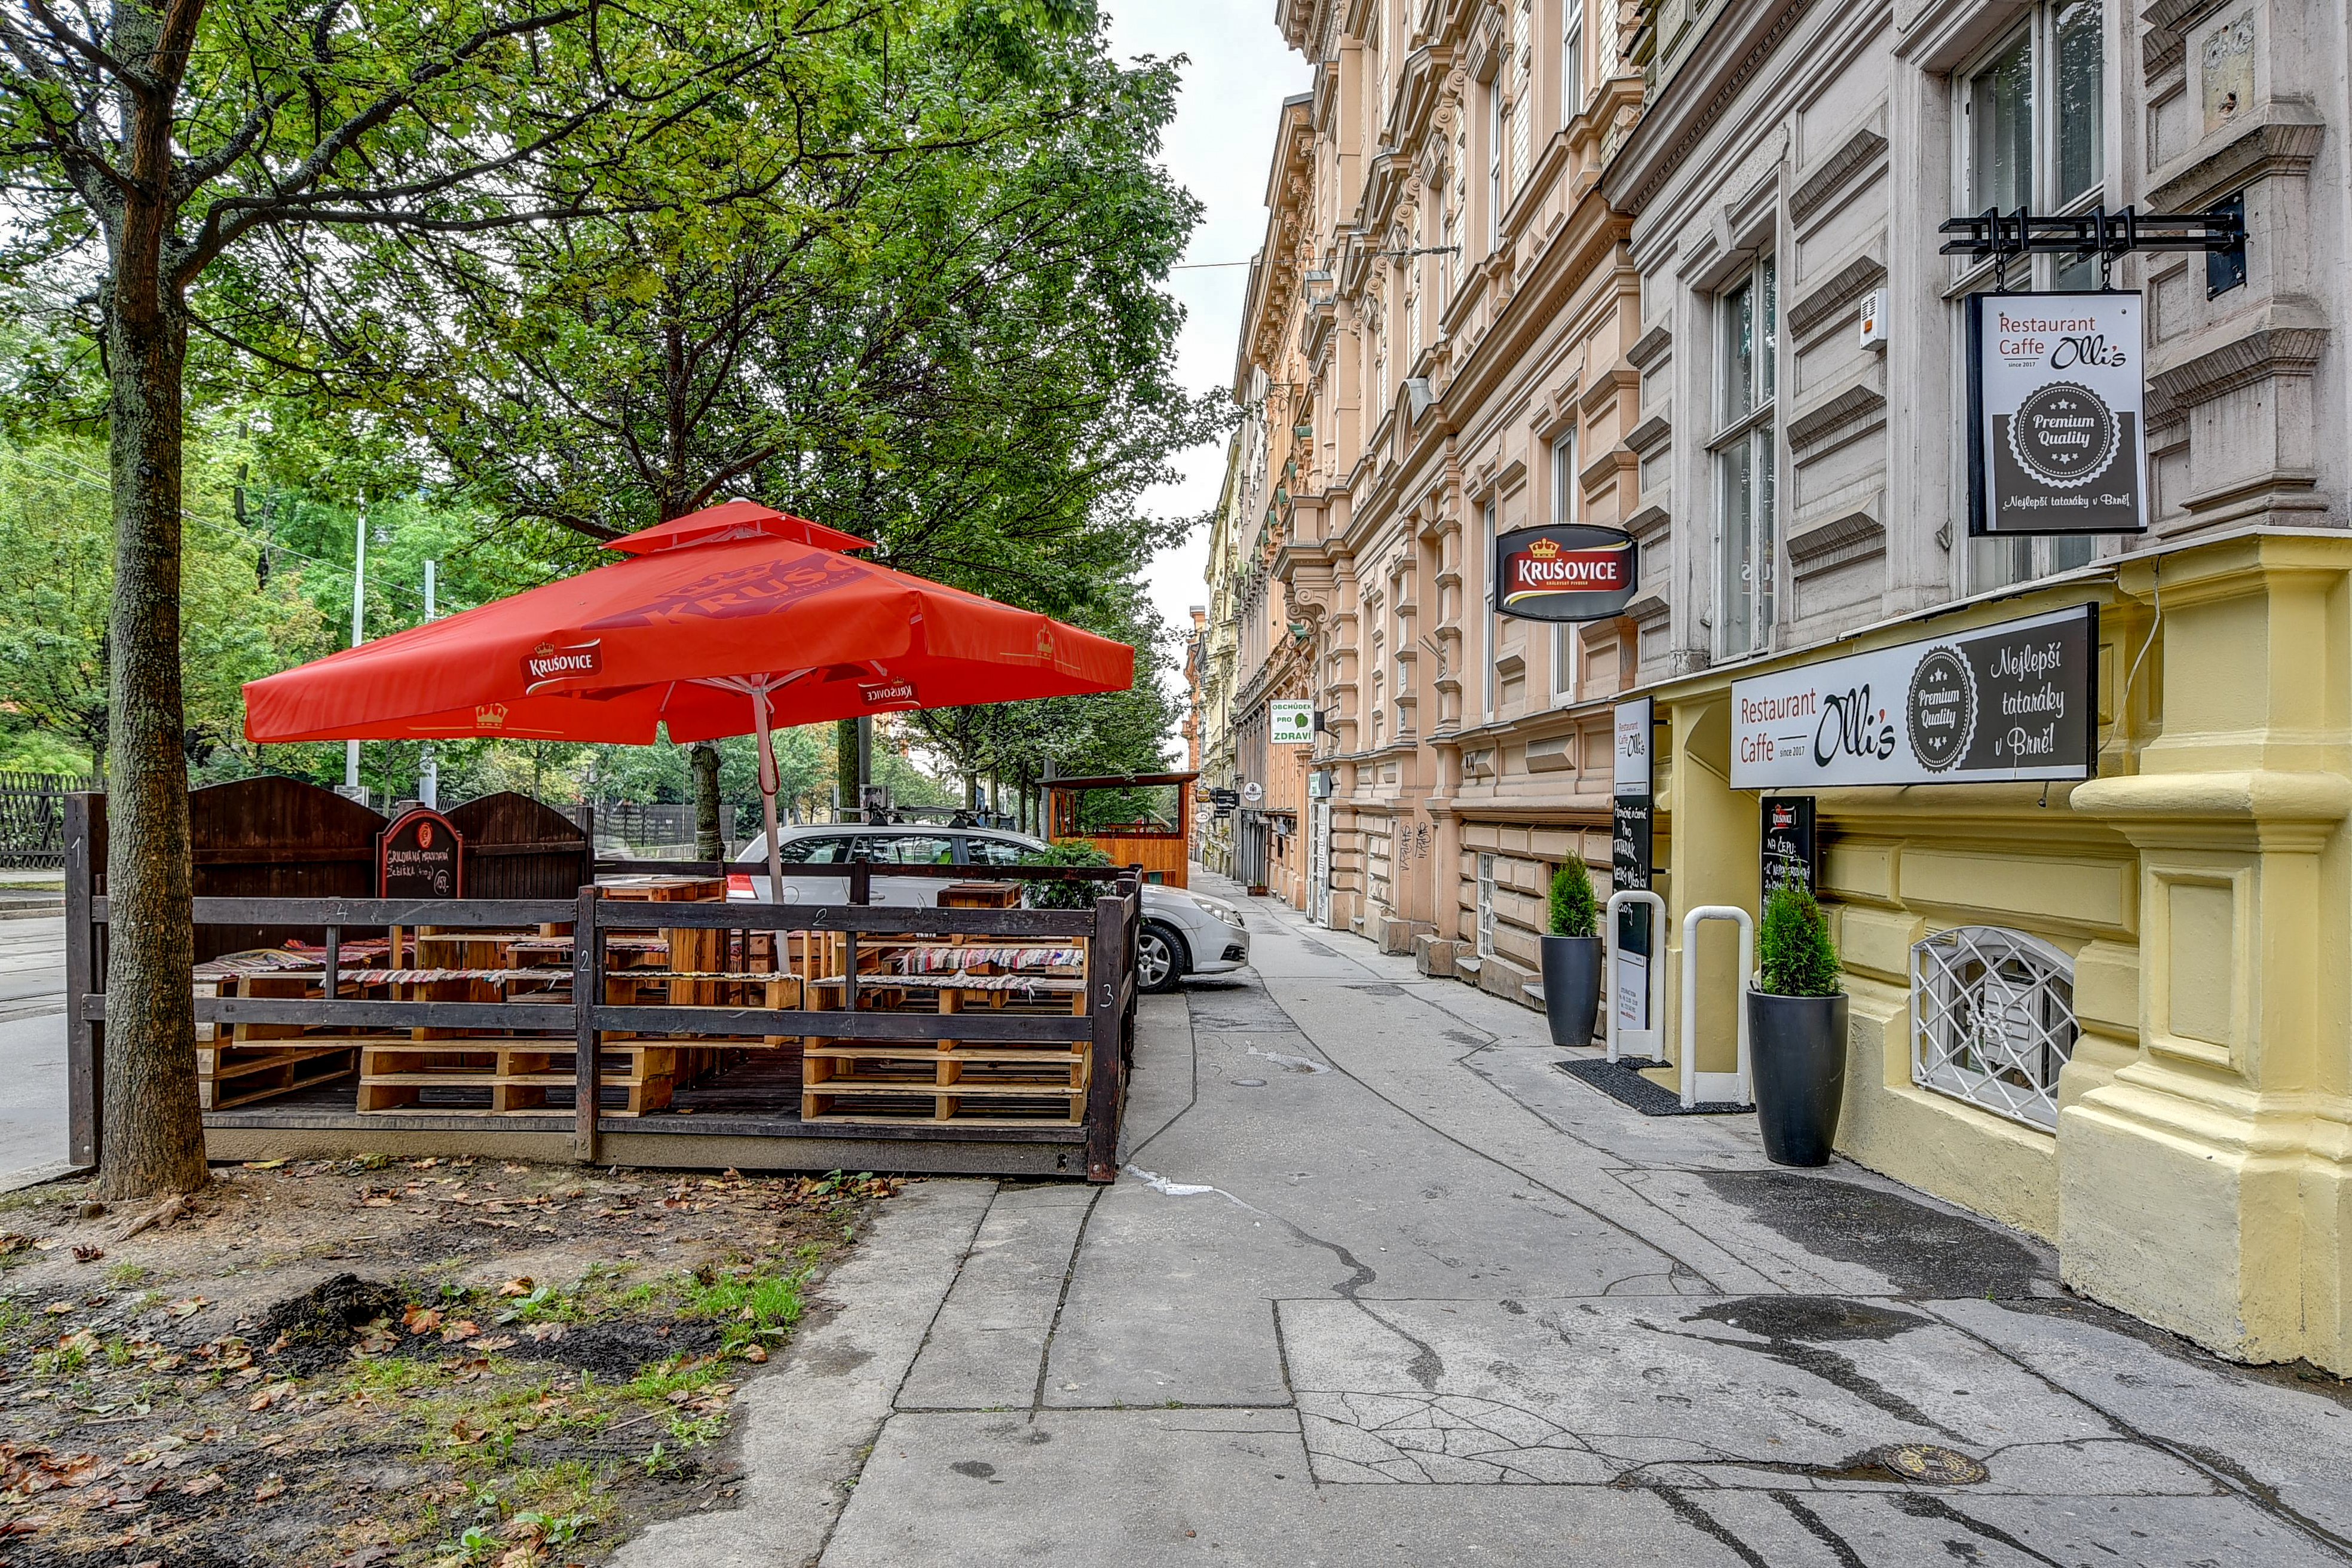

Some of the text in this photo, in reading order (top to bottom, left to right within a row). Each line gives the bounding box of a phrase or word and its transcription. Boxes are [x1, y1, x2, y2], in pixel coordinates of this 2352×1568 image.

[1999, 317, 2096, 333] Restaurant
[1999, 339, 2045, 355] Caffe
[2051, 334, 2127, 370] Olli's
[2033, 415, 2095, 429] Premium
[2038, 431, 2091, 448] Quality
[2002, 493, 2130, 512] Nejlepší tataráky v Brně!
[1518, 558, 1617, 586] KRUŠOVICE
[529, 654, 593, 678] KRUŠOVICE
[1990, 641, 2062, 682] Nejlepší
[1741, 687, 1817, 725] Restaurant
[1918, 687, 1960, 707] Premium
[2002, 682, 2065, 718] tataráky
[1619, 721, 1639, 732] Restaurant
[1814, 683, 1896, 767] Olli's
[1921, 709, 1956, 730] Quality
[1273, 730, 1312, 740] ZDRAVÍ
[1618, 734, 1628, 745] Caffe
[1995, 722, 2054, 756] v Brně!
[1741, 733, 1774, 764] Caffe
[1780, 745, 1805, 758] since 2017
[71, 836, 81, 869] 1
[1767, 835, 1796, 854] NA ČEPU:
[386, 849, 421, 864] GRILOVANÁ
[336, 903, 349, 921] 4
[813, 908, 828, 927] 2
[579, 950, 590, 972] 2
[1100, 984, 1114, 1007] 3
